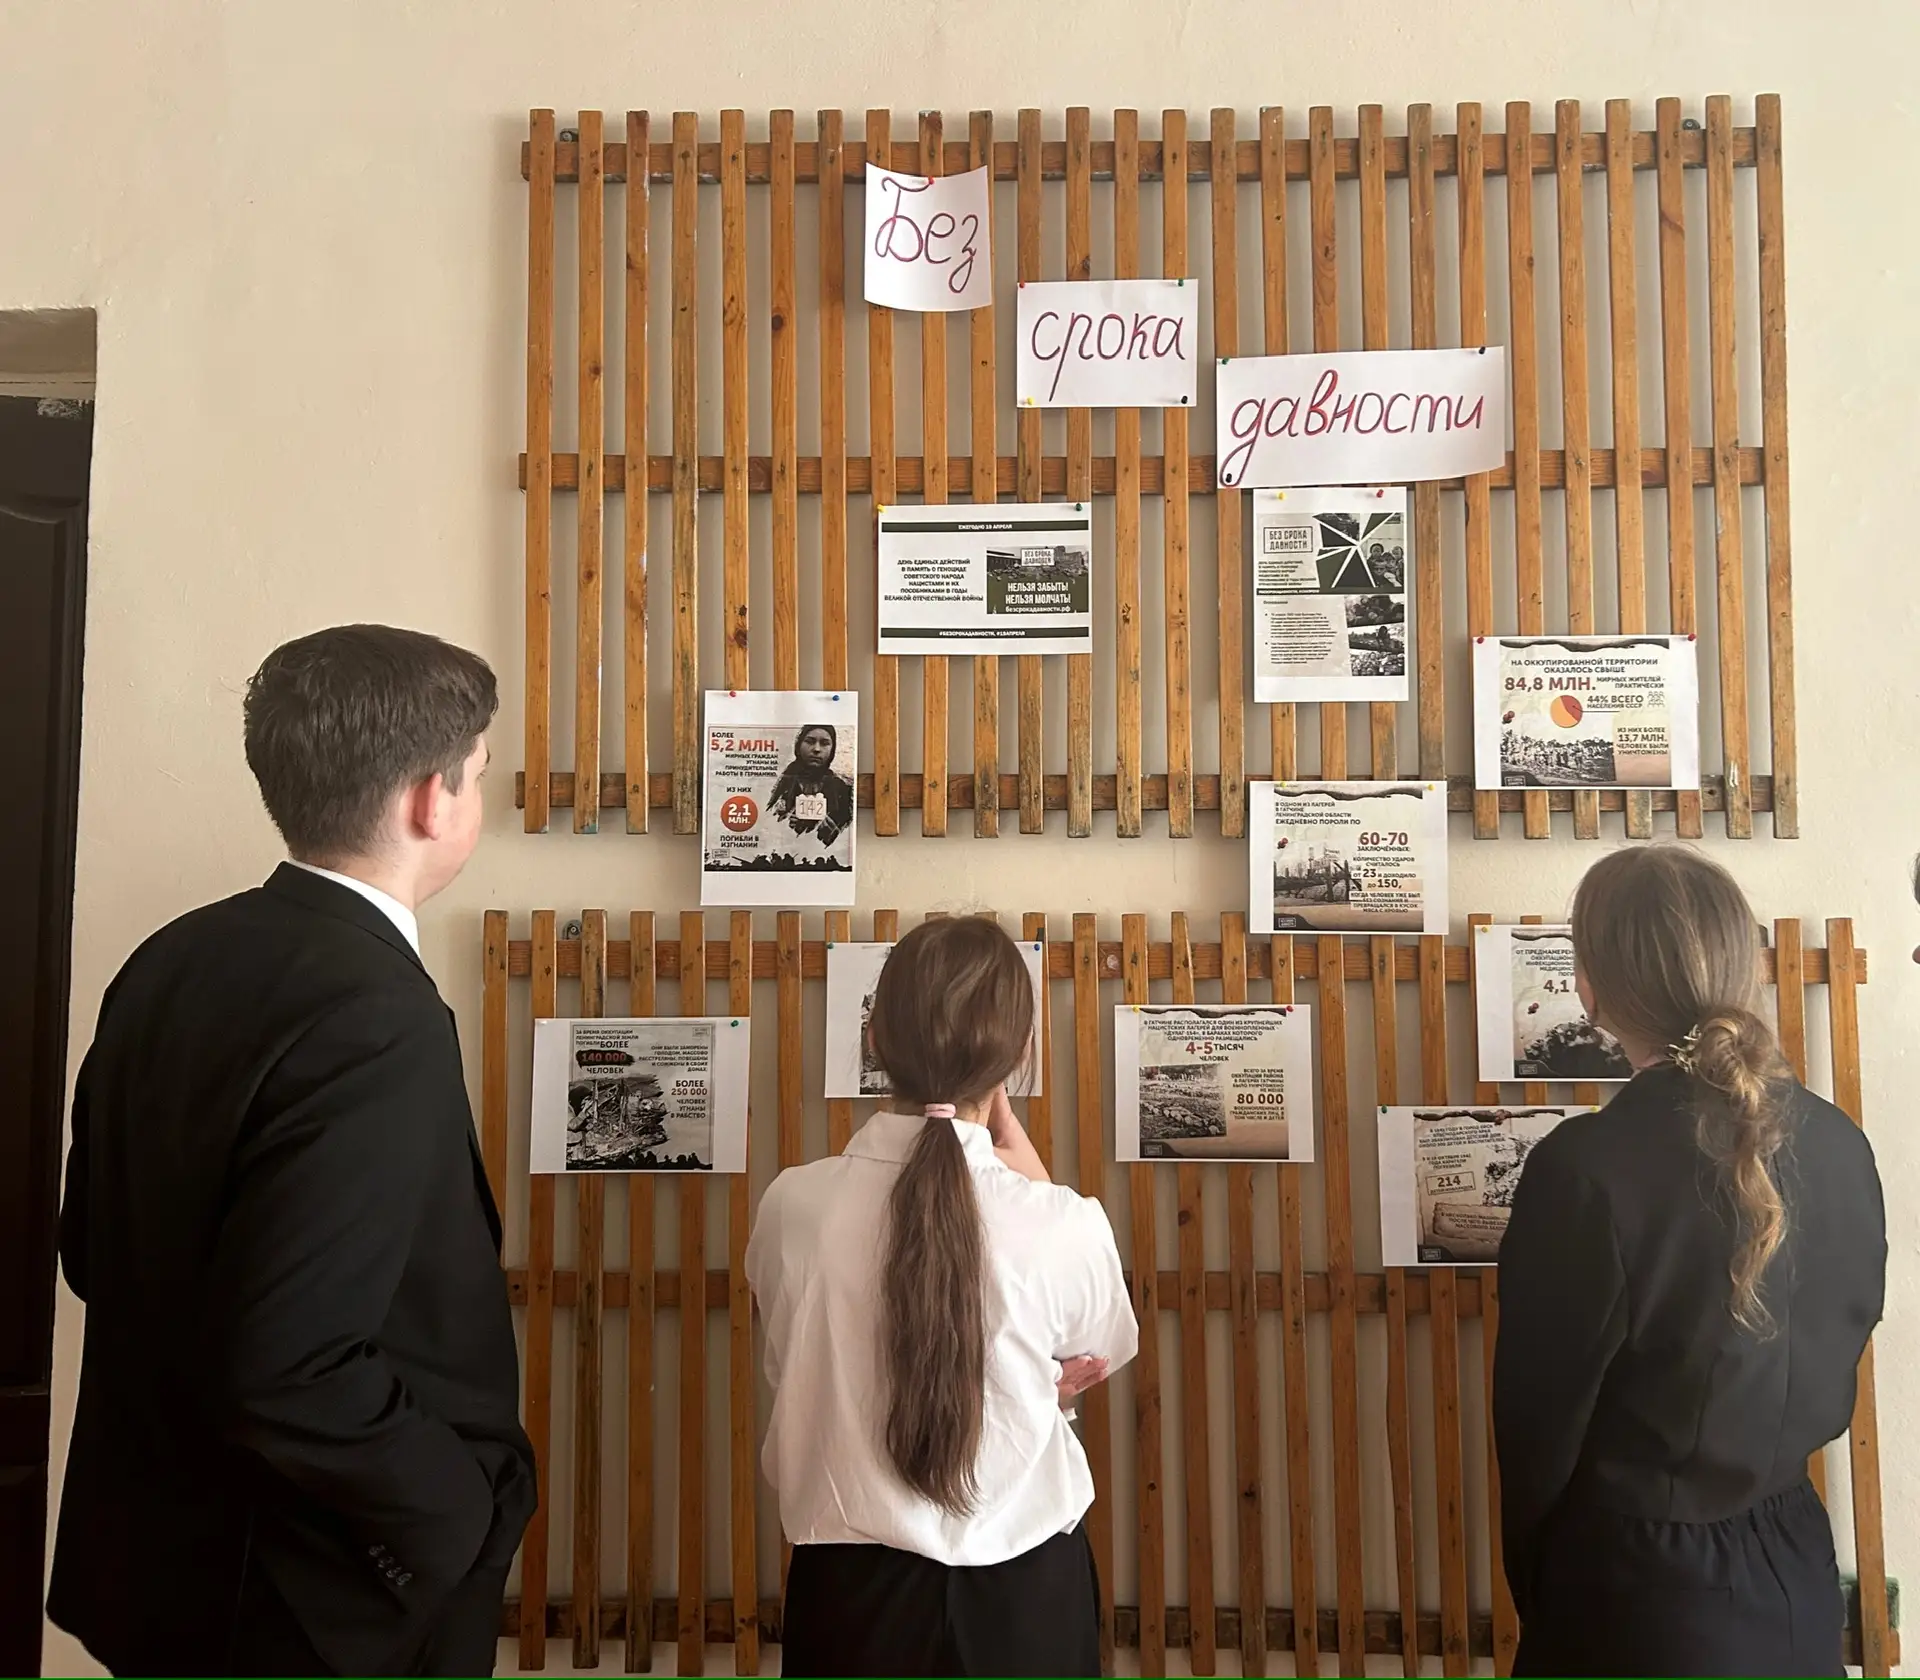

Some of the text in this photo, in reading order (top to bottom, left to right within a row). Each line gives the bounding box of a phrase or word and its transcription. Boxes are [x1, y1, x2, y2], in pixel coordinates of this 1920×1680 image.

[873, 176, 980, 294] Без
[1030, 311, 1186, 402] срока
[1218, 369, 1484, 488] давности
[1269, 530, 1308, 540] БЕЗ СРОКА
[1270, 540, 1308, 550] ДАВНОСТИ
[1007, 583, 1036, 592] НЕЛЬЗЯ
[1005, 594, 1034, 604] НЕЛЬЗЯ
[1524, 658, 1603, 666] ОККУПИРОВАННОЙ
[1504, 677, 1596, 692] 84,8 МЛН.
[1587, 695, 1644, 703] 44% ВСЕГО
[1618, 734, 1668, 742] 13,7 МЛН.
[711, 739, 779, 752] 5,2 МЛН.
[728, 804, 751, 817] 2,1
[799, 800, 824, 817] 142
[728, 816, 751, 824] МЛН.
[1360, 832, 1408, 846] 60-70
[1363, 869, 1377, 878] 23
[1377, 879, 1402, 889] 150,
[1543, 979, 1570, 994] 4,1
[600, 1040, 629, 1048] БОЛЕЕ
[1185, 1041, 1244, 1055] 4-5 ТЫСЯЧ
[581, 1052, 627, 1062] 140 000
[676, 1080, 704, 1088] БОЛЕЕ
[671, 1088, 708, 1096] 250 000
[1237, 1093, 1284, 1105] 80 000
[1437, 1175, 1461, 1188] 214
